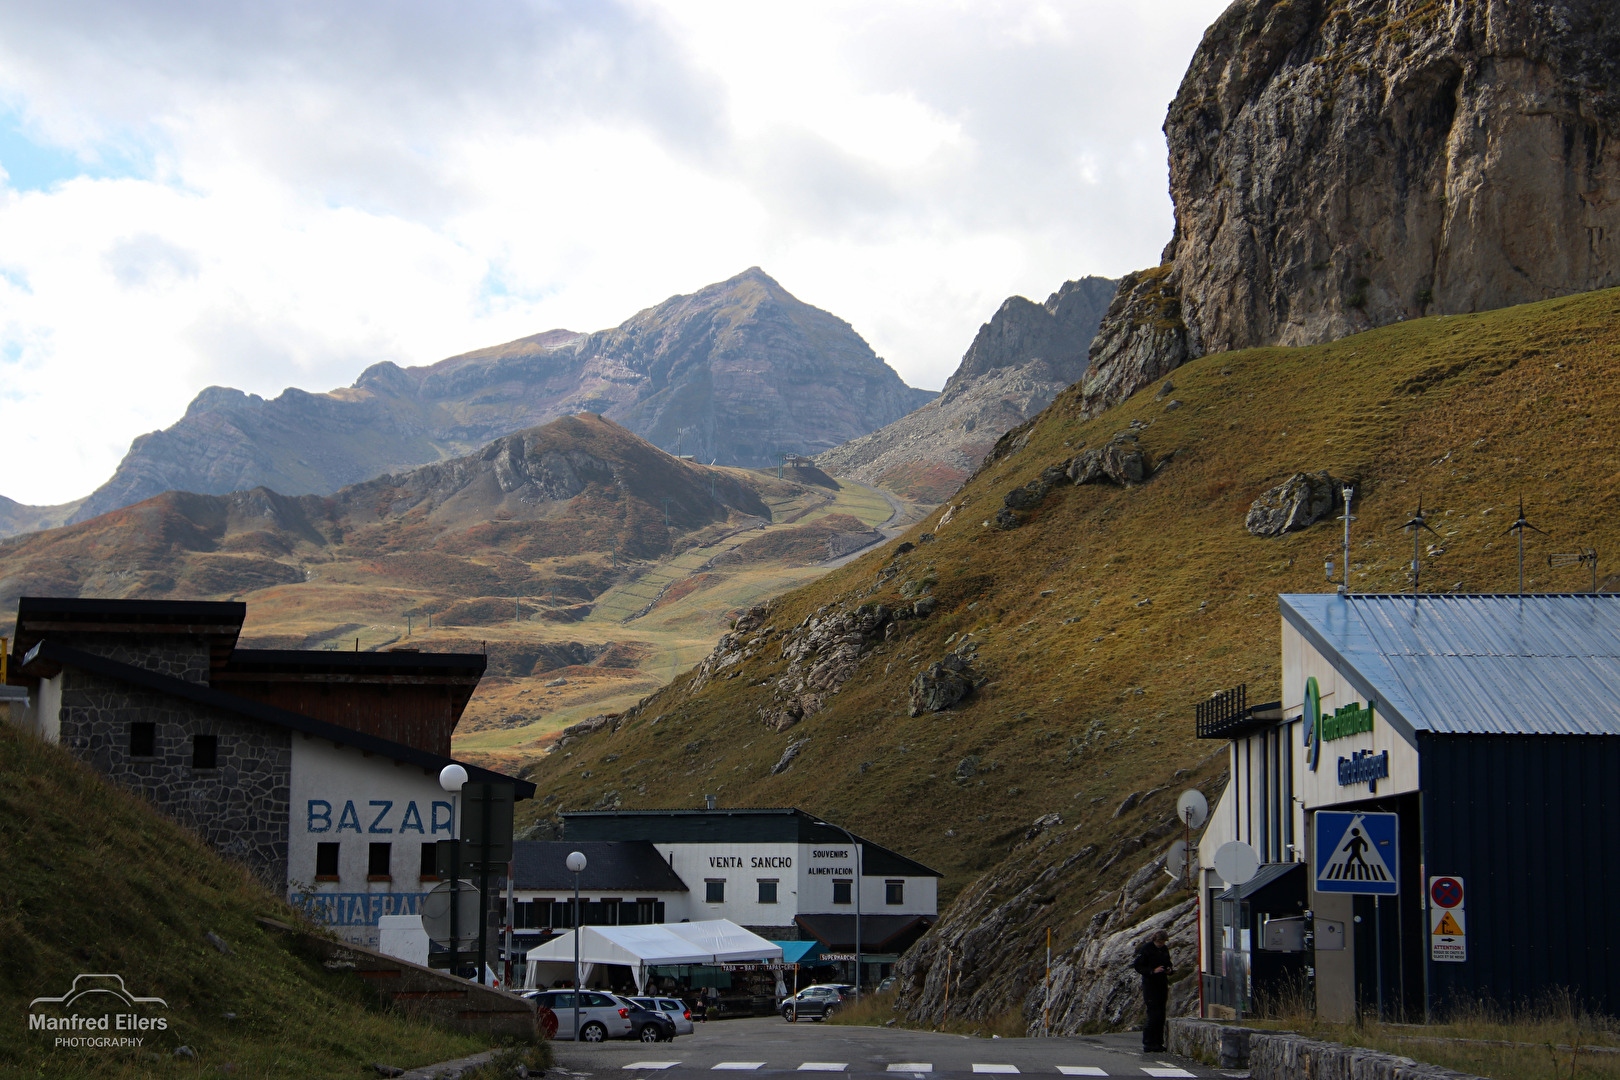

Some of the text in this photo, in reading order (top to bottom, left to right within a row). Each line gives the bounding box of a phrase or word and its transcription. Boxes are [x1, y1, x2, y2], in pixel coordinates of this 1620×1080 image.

[307, 799, 453, 834] BAZAR
[813, 850, 848, 858] SOUVENIRS
[709, 857, 792, 868] VENTA SANCHO
[808, 867, 853, 875] ALIMENTACION
